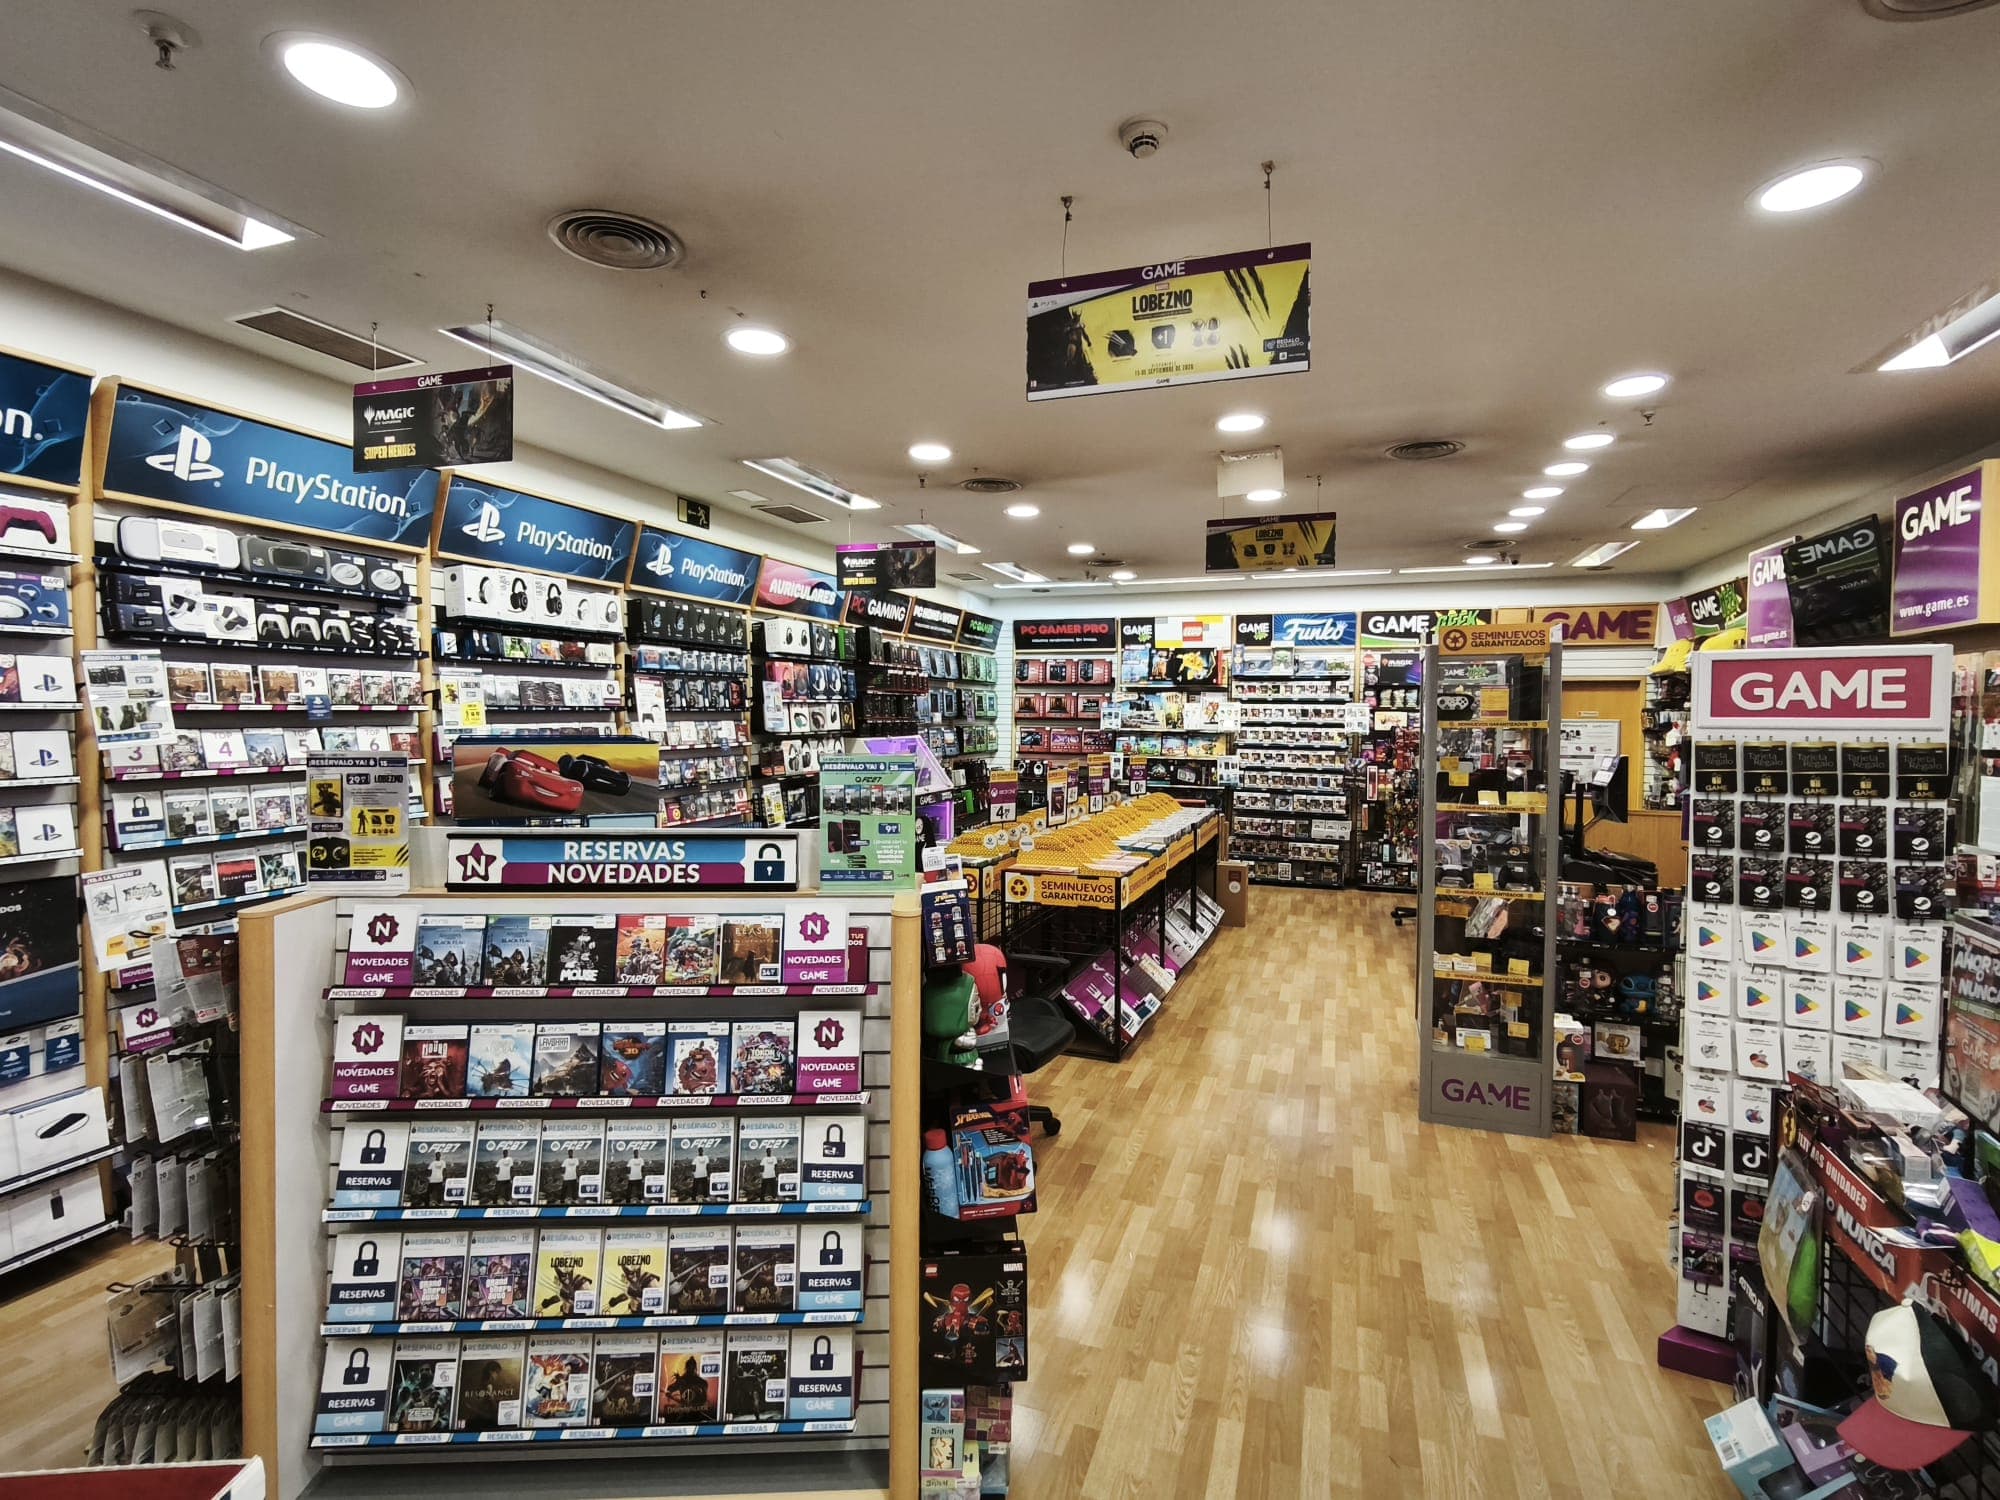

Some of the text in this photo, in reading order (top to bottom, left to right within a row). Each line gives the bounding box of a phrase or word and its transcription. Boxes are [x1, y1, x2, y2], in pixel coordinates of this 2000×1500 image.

[1141, 261, 1186, 280] GAME
[1132, 288, 1193, 314] LOBEZNO
[417, 374, 443, 387] GAME
[374, 406, 415, 421] MAGIC
[364, 443, 416, 460] SUPER HEROES
[246, 457, 407, 518] PlayStation
[1901, 485, 1972, 541] GAME
[1255, 528, 1284, 539] LOBEZNO
[517, 522, 612, 561] PlayStation
[681, 557, 744, 587] PlayStation
[769, 578, 837, 606] AURICULARES
[850, 596, 906, 621] PC GAMING
[1691, 595, 1720, 620] GAME
[1899, 595, 1969, 619] www.game.es
[1020, 623, 1109, 635] PC GAMER PRO
[1123, 624, 1152, 636] GAME
[1238, 622, 1270, 633] GAME
[1282, 618, 1347, 641] Funko
[1368, 615, 1430, 634] GAME
[1542, 610, 1652, 641] GAME
[1471, 630, 1546, 641] SEMINUEVOS
[1471, 639, 1546, 648] GARANTIZADOS
[1730, 668, 1907, 711] GAME
[218, 742, 233, 757] 4
[298, 738, 310, 752] 5
[371, 737, 380, 751] 6
[563, 842, 686, 861] RESERVAS
[467, 855, 486, 875] N
[549, 863, 700, 884] NOVEDADES
[1041, 880, 1113, 894] SEMINUEVOS
[1041, 891, 1115, 904] GARANTIZADOS
[375, 921, 391, 937] N
[808, 920, 821, 935] N
[351, 958, 409, 967] NOVEDADES
[787, 956, 841, 964] NOVEDADES
[363, 973, 393, 983] GAME
[560, 969, 599, 982] MOUSE
[800, 971, 828, 980] GAME
[332, 989, 377, 997] NOVEDADES
[414, 989, 459, 997] NOVEDADES
[576, 988, 621, 996] NOVEDADES
[142, 1013, 153, 1023] N
[128, 1031, 171, 1046] NOVEDADES
[360, 1031, 375, 1046] N
[821, 1026, 836, 1041] N
[337, 1067, 394, 1076] NOVEDADES
[801, 1063, 855, 1071] NOVEDADES
[348, 1084, 379, 1093] GAME
[813, 1078, 842, 1088] GAME
[1441, 1078, 1531, 1111] GAME
[335, 1101, 381, 1109] NOVEDADES
[417, 1100, 463, 1108] NOVEDADES
[498, 1099, 544, 1107] NOVEDADES
[811, 1169, 854, 1179] RESERVAS
[345, 1177, 391, 1186] RESERVAS
[1825, 1160, 1868, 1212] UNIDADES
[818, 1185, 846, 1196] GAME
[350, 1193, 381, 1203] GAME
[1836, 1204, 1896, 1277] NUNCA
[551, 1257, 583, 1268] LOBEZNO
[617, 1255, 651, 1266] LOBEZNO
[808, 1277, 852, 1287] RESERVAS
[339, 1289, 385, 1299] RESERVAS
[815, 1294, 844, 1304] GAME
[345, 1305, 376, 1316] GAME
[799, 1384, 842, 1393] RESERVAS
[328, 1398, 375, 1408] RESERVAS
[805, 1400, 834, 1411] GAME
[334, 1415, 365, 1427] GAME
